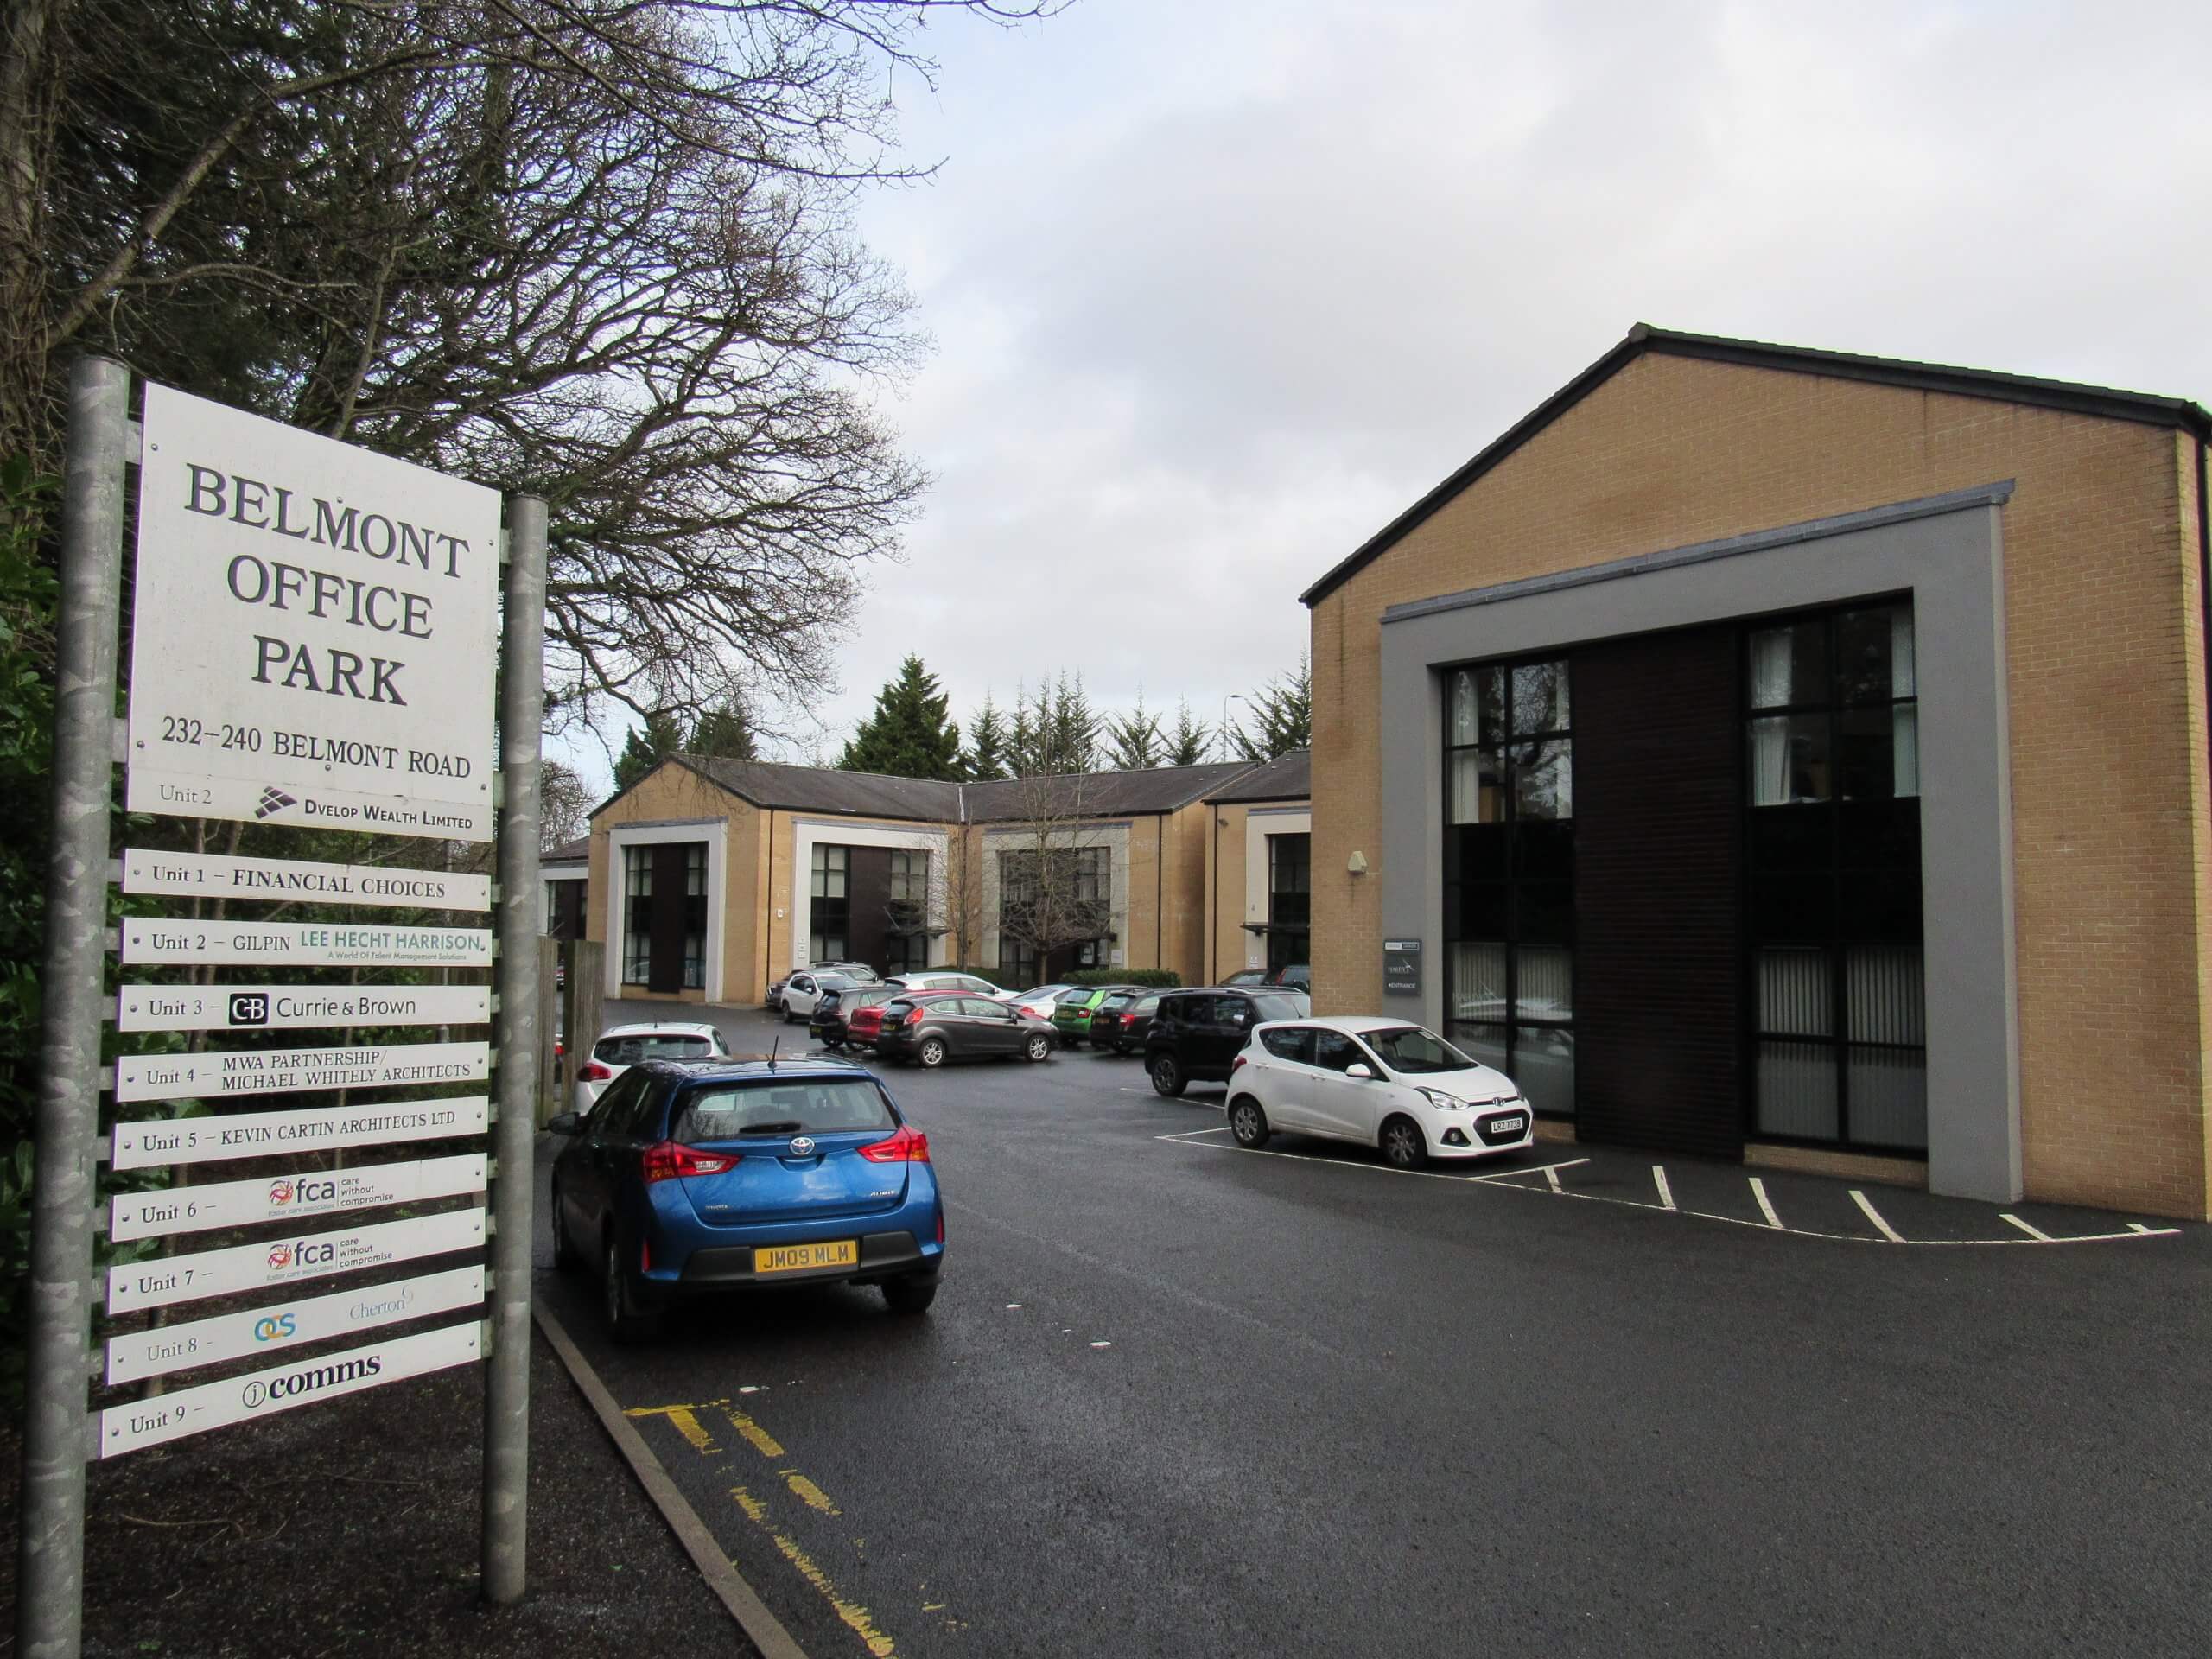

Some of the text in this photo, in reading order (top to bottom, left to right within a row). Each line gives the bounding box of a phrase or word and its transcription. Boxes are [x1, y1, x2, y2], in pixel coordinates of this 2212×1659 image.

[184, 462, 470, 578] BELMONT
[227, 554, 433, 639] OFFICE
[251, 634, 407, 706] PARK
[162, 715, 471, 778] 232-240 BELMONT ROAD
[159, 785, 212, 804] Unit 2
[305, 799, 473, 830] DVELOP WEALTH LIMITED
[152, 866, 190, 881] Unit
[197, 869, 205, 882] 1
[232, 869, 353, 893] FINANCIAL
[361, 878, 445, 898] CHOICES
[152, 934, 189, 950] Unit
[196, 934, 206, 950] 2
[233, 935, 290, 950] GILPIN
[302, 931, 328, 947] LEE
[335, 931, 390, 948] HECHT
[396, 933, 480, 950] HARRISON
[149, 1000, 186, 1015] Unit
[194, 1000, 202, 1015] 3
[277, 997, 338, 1017] Currie
[342, 1002, 354, 1015] &
[359, 997, 416, 1015] Brown
[223, 1056, 264, 1071] MWA
[147, 1070, 180, 1084] Unit
[187, 1069, 194, 1082] 4
[222, 1064, 470, 1090] MICHAEL WHITELY ARCHITECTS
[143, 1134, 180, 1151] Unit
[188, 1132, 197, 1147] 5
[221, 1127, 272, 1145] KEVIN
[278, 1121, 334, 1140] CARTIN
[340, 1113, 427, 1135] ARCHITECTS
[432, 1111, 455, 1125] LTD
[296, 1179, 335, 1204] fca
[340, 1185, 374, 1197] without
[341, 1177, 360, 1186] care
[141, 1205, 178, 1223] Unit
[188, 1201, 197, 1217] 6
[340, 1193, 393, 1207] compromise
[295, 1241, 334, 1267] fca
[340, 1237, 359, 1247] care
[340, 1245, 372, 1257] without
[340, 1252, 392, 1268] compromise
[764, 1244, 849, 1268] JM09 MLM
[139, 1274, 176, 1293] Unit
[185, 1269, 194, 1285] 7
[147, 1342, 183, 1361] Unit
[188, 1338, 197, 1352] 8
[350, 1299, 405, 1319] Cherton
[130, 1411, 168, 1433] Unit
[175, 1406, 186, 1422] 9
